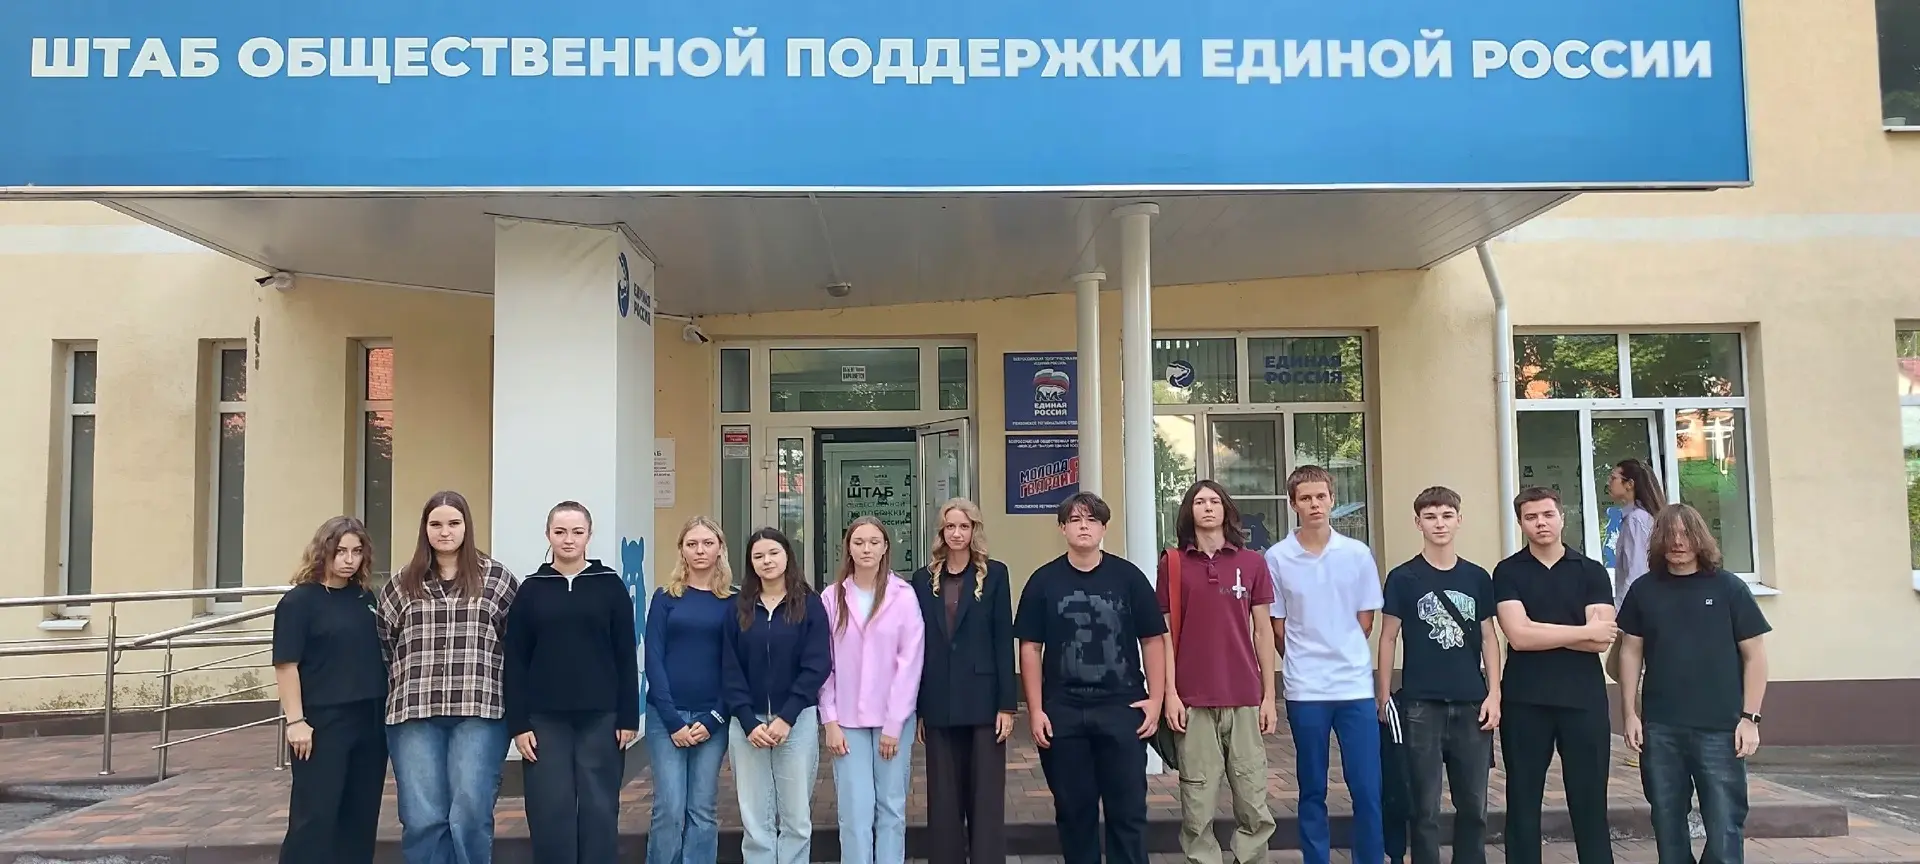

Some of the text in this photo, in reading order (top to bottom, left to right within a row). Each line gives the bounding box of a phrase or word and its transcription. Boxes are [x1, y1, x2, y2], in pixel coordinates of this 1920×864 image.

[31, 27, 1712, 84] ШТАБ ОБЩЕСТВЕННОЙ ПОДДЕРЖКИ ЕДИНОЙ РОССИИ
[1264, 355, 1342, 370] ЕДИНАЯ
[1264, 370, 1343, 385] РОССИЯ
[846, 486, 894, 498] ШТАБ
